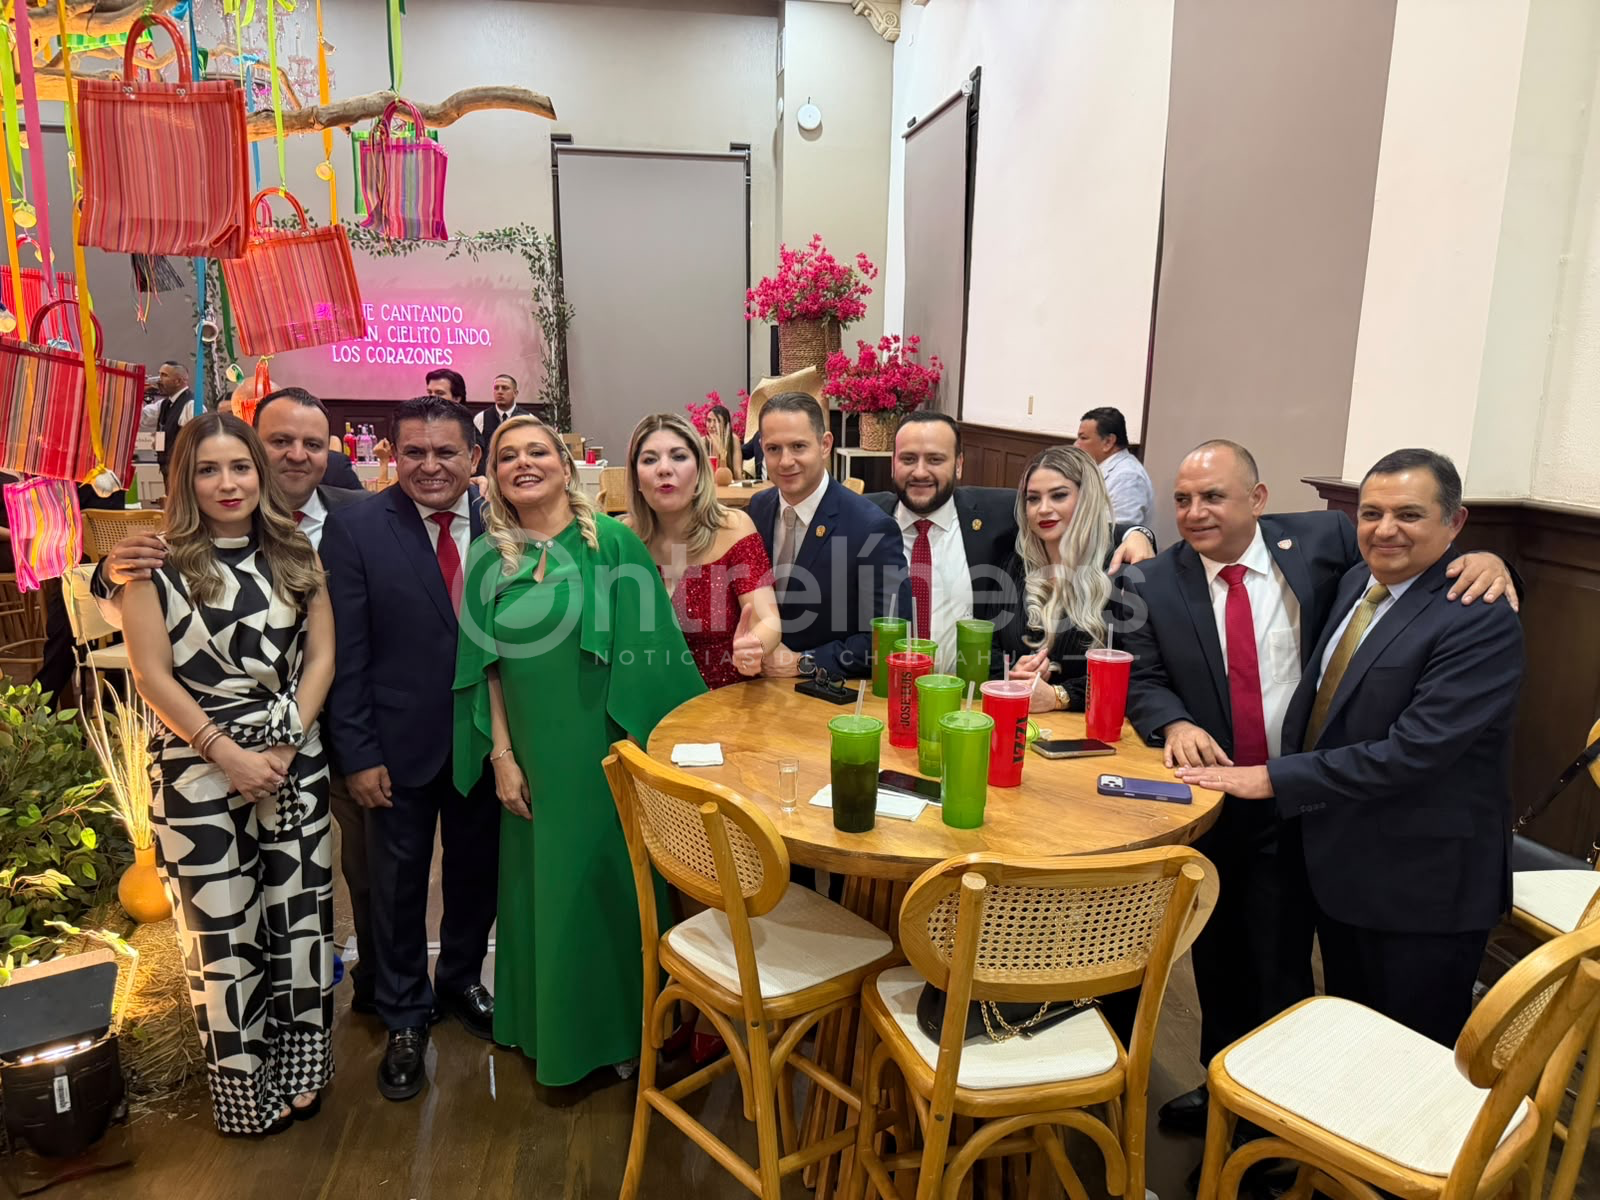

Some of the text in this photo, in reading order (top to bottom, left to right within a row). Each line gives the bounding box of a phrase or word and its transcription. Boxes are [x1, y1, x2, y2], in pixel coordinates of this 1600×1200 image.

[381, 303, 463, 323] CANTANDO
[447, 327, 492, 347] LINDO,
[332, 345, 453, 365] LOS CORAZONES
